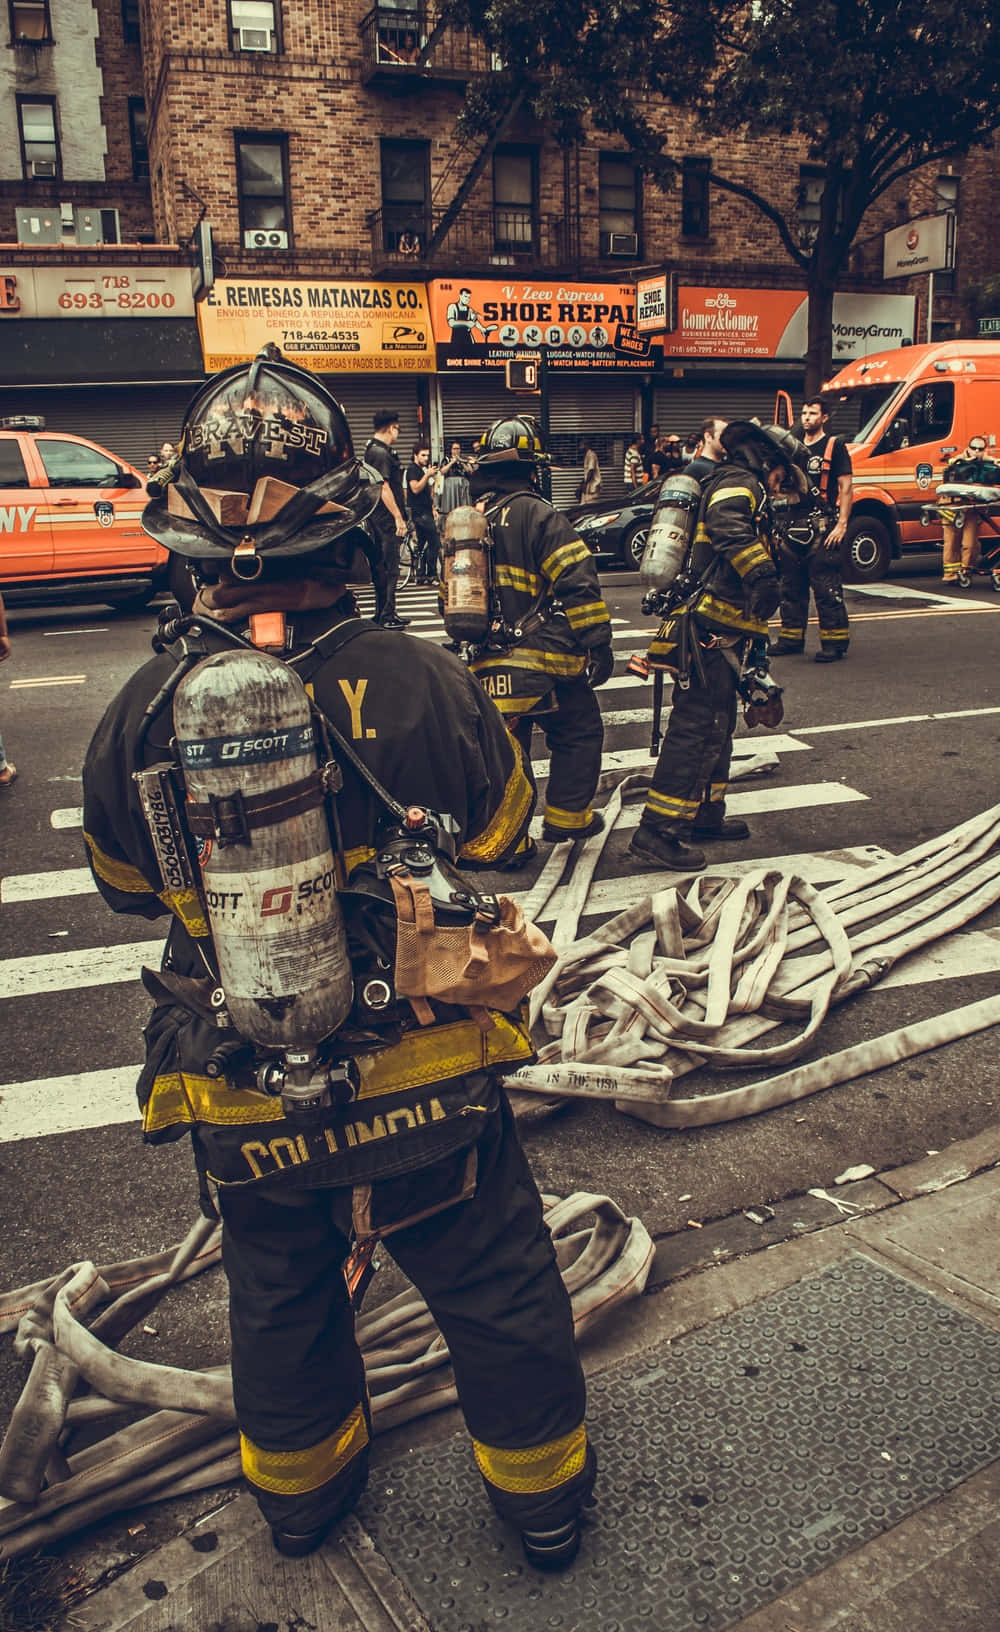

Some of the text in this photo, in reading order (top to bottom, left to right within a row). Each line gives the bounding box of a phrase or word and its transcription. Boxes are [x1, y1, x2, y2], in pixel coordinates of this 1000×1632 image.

[101, 276, 130, 289] 718
[58, 293, 175, 309] 693-8200
[226, 286, 303, 307] REMESAS
[308, 288, 393, 309] MATANZAS
[396, 289, 423, 309] CO.
[502, 286, 605, 304] V. Zeev Express
[644, 289, 662, 305] SHOE
[216, 309, 416, 319] ENVIOS DE DINERO A REPUBLICA DOMINICANA
[483, 303, 635, 324] SHOE REPAI
[639, 303, 665, 320] REPAIR
[266, 320, 373, 329] CENTRO Y SUR AMERICA
[282, 331, 359, 341] 718-462-4535
[313, 358, 346, 369] RECARGAS
[353, 358, 373, 369] PAGOS
[374, 358, 382, 368] DE
[188, 414, 328, 457] BRAVEST
[480, 673, 512, 697] TABI
[243, 735, 289, 752] SCOTT
[206, 890, 243, 909] OTT
[547, 1073, 560, 1083] IN
[568, 1070, 592, 1087] THE
[596, 1077, 618, 1089] USA
